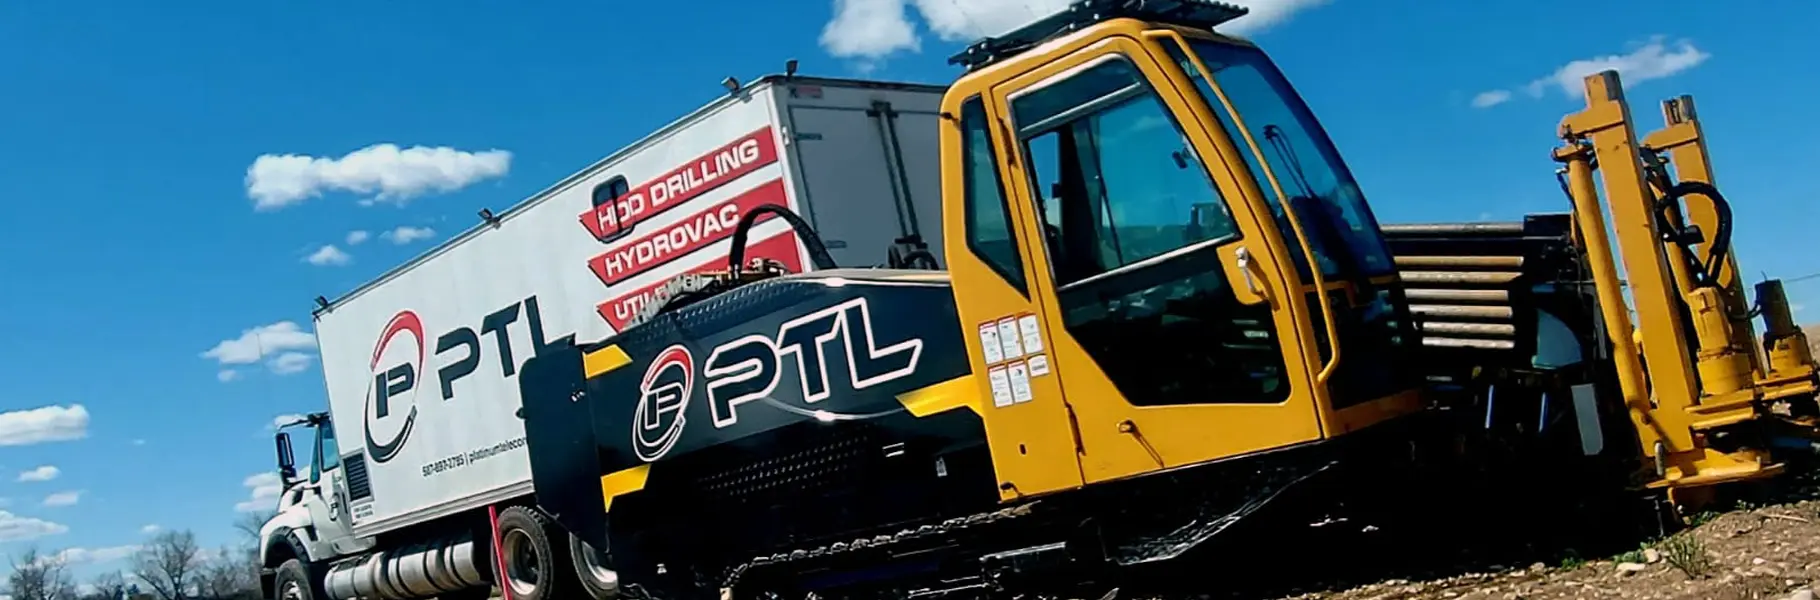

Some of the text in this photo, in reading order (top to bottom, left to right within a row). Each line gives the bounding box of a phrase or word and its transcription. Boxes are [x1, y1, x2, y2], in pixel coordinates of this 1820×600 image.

[650, 138, 760, 207] DRILLING
[605, 204, 740, 277] HYDROVAC
[435, 295, 576, 401] PTL
[703, 297, 923, 429] PTL
